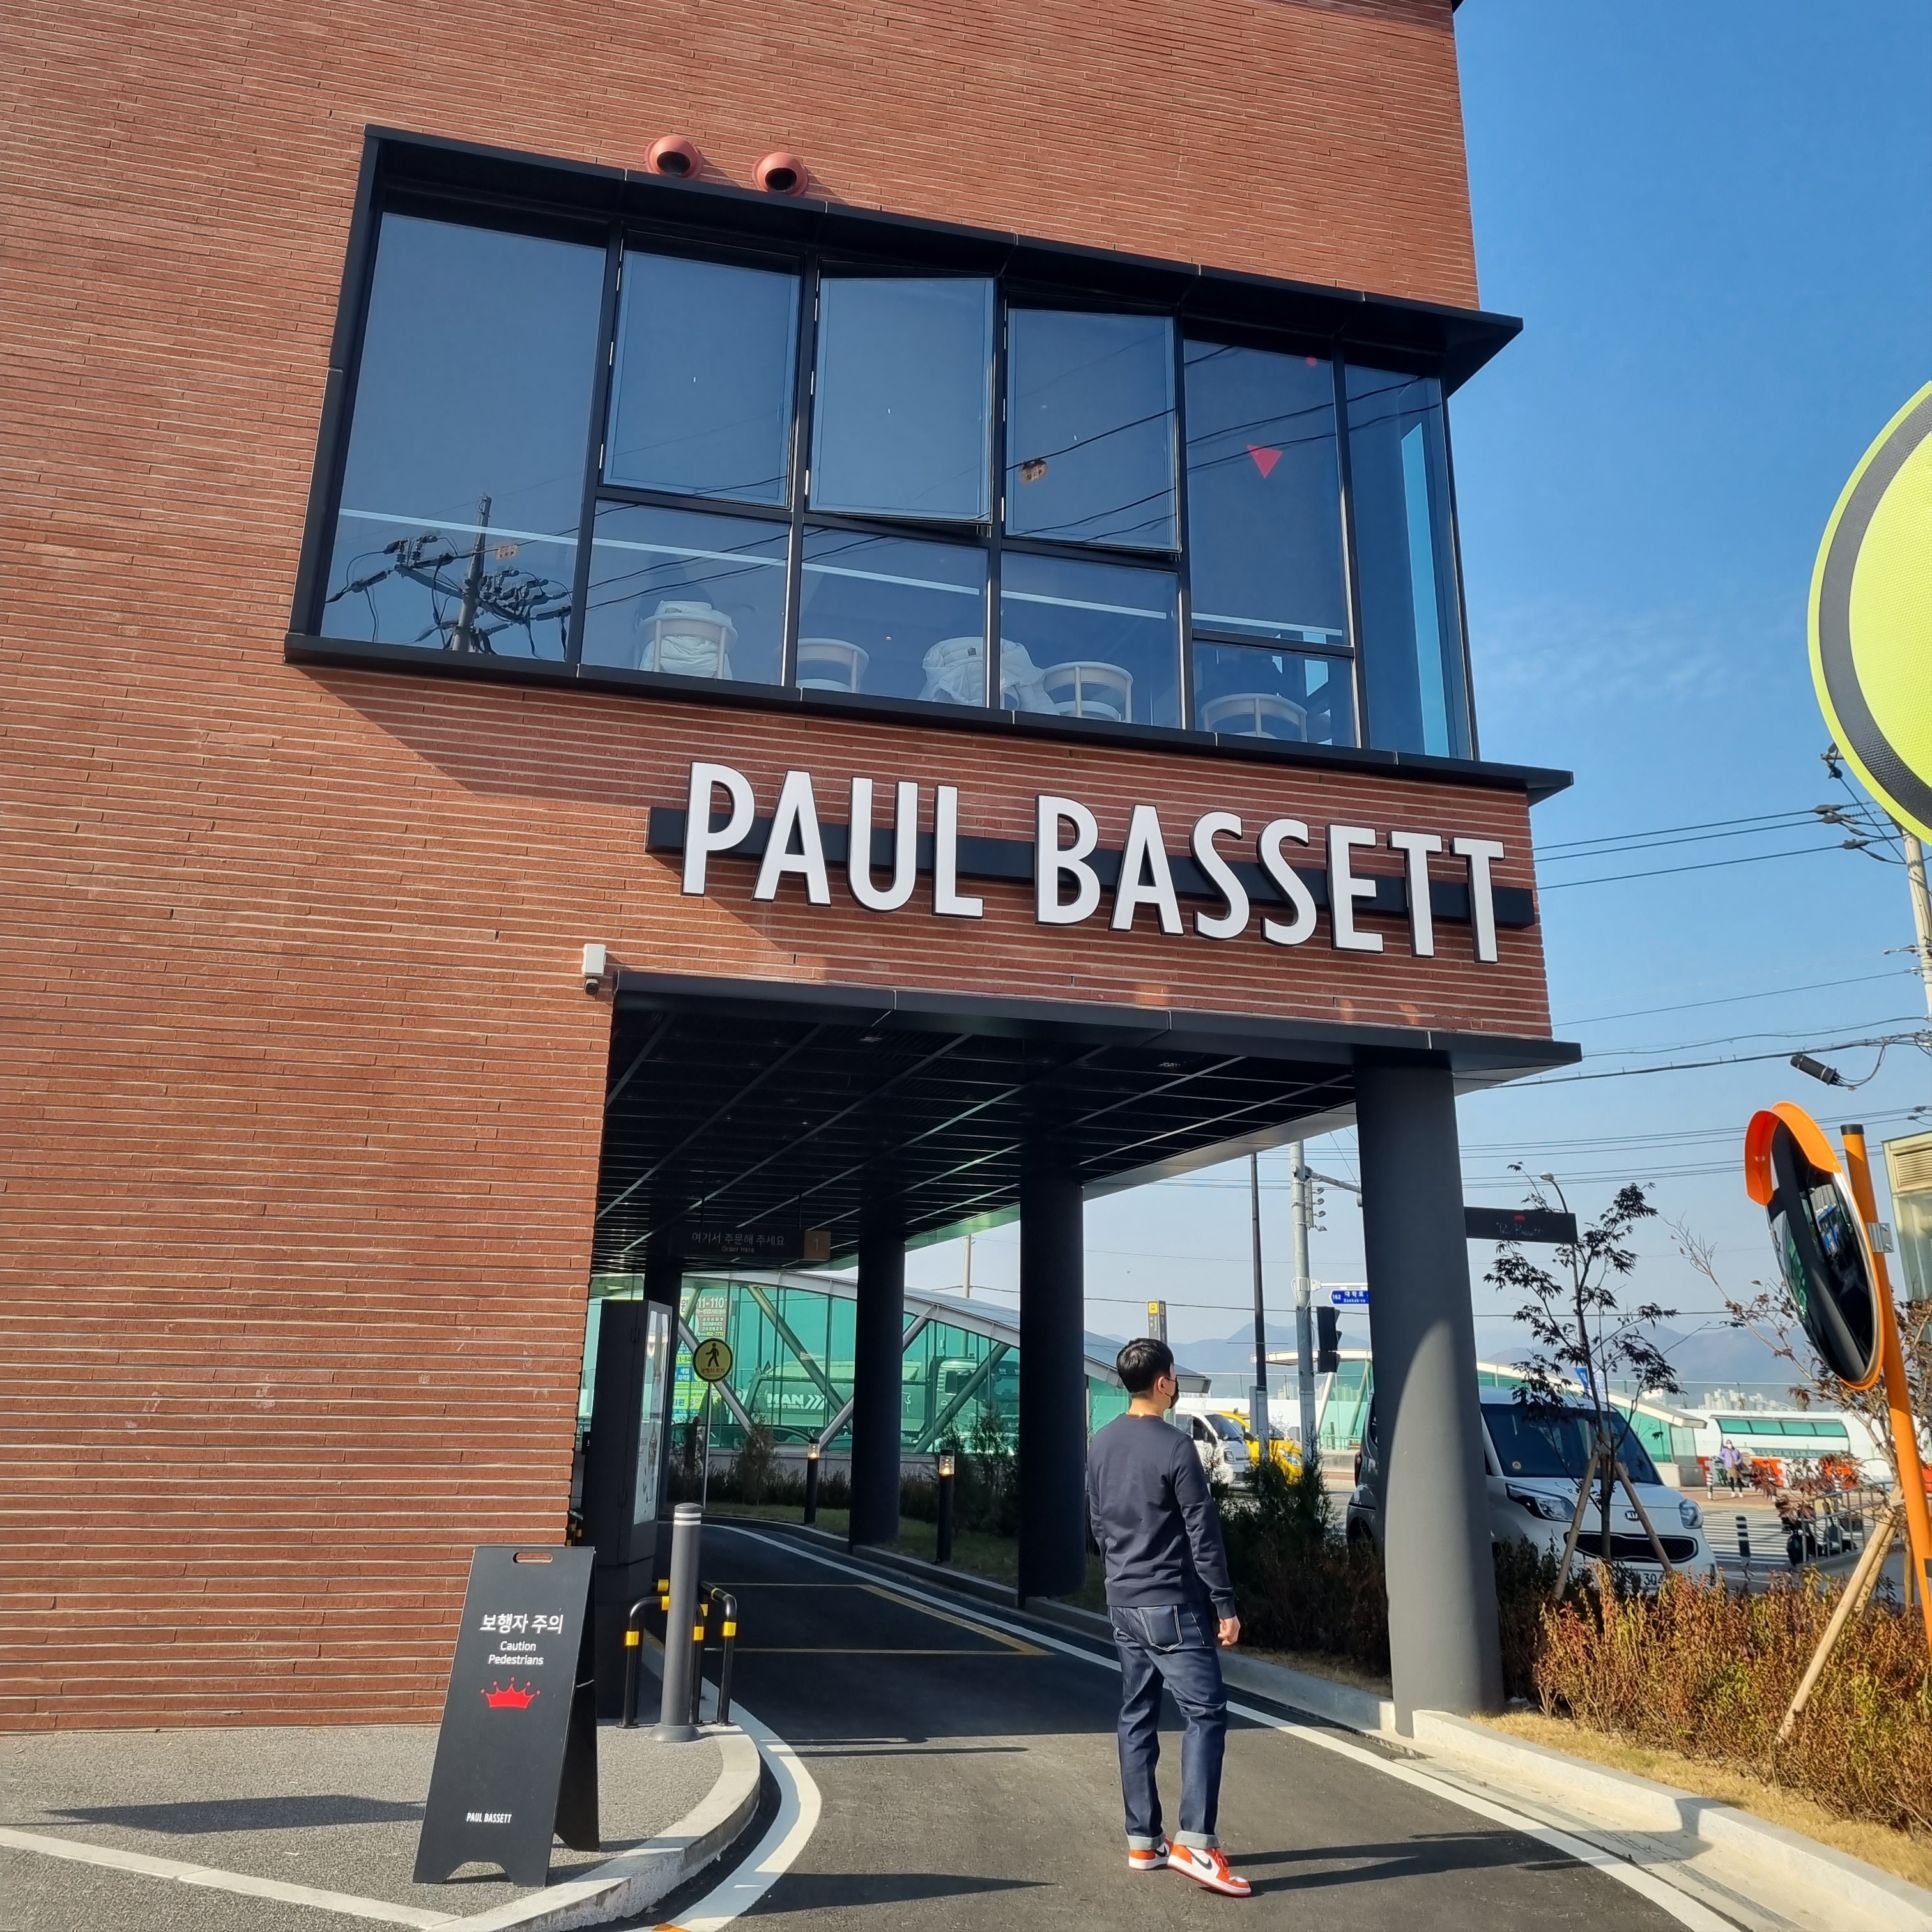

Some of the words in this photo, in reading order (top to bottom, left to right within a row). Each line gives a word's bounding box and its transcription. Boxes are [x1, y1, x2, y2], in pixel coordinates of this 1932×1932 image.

[682, 762, 984, 919] PAUL
[1036, 794, 1506, 964] BASSETT
[692, 1232, 721, 1244] 여기서
[724, 1233, 753, 1245] 주문해
[756, 1234, 785, 1246] 주세요
[767, 1393, 804, 1405] MAN
[479, 1613, 528, 1634] 보행자
[531, 1614, 564, 1634] 주의
[500, 1641, 537, 1652] Caution
[487, 1654, 544, 1666] Pedestrians
[466, 1812, 482, 1822] PAUL
[484, 1813, 512, 1823] BASSETT
